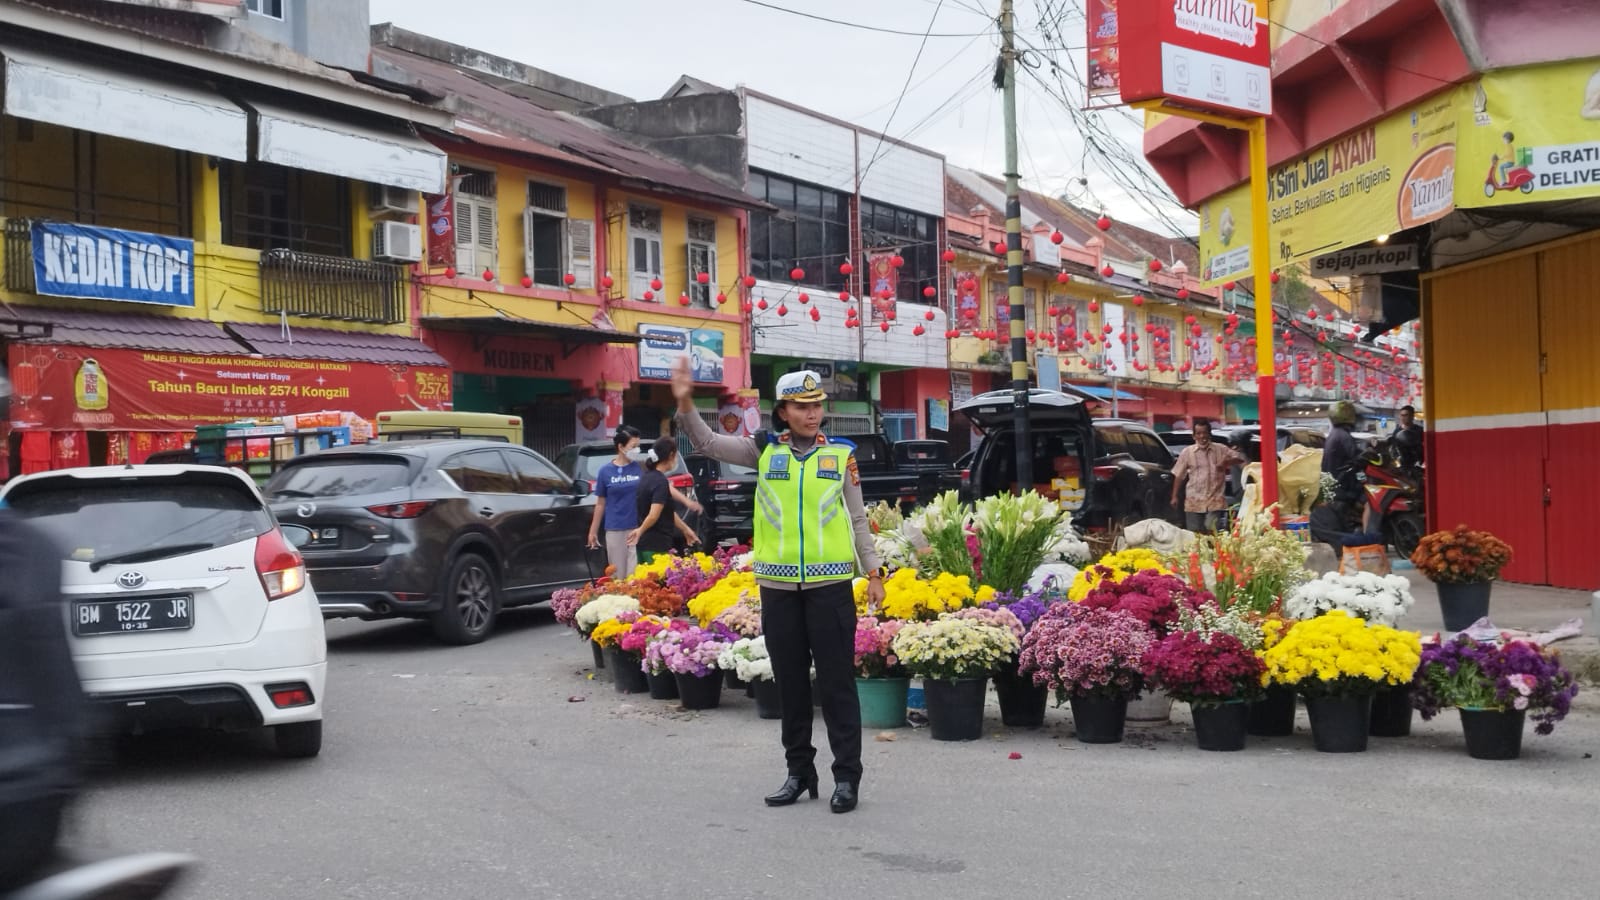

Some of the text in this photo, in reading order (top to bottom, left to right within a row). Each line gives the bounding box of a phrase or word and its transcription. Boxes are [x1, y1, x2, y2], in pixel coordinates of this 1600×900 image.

[1276, 164, 1299, 199] Sini
[1301, 147, 1329, 189] Jual
[1331, 126, 1377, 177] AYAM
[1339, 181, 1354, 199] dan
[1356, 165, 1391, 194] Higienis
[43, 232, 189, 295] KEDAI KOPI
[1315, 246, 1413, 272] sejajarkopi
[143, 354, 177, 363] MAJELIS
[178, 356, 204, 364] TINGGI
[205, 357, 233, 366] AGAMA
[279, 360, 315, 369] INDONESIA
[483, 350, 555, 372] MODREN
[217, 370, 291, 382] Selamat Hari Raya
[148, 380, 350, 399] Tahun Baru Imlek 2574 Kongzili
[419, 382, 449, 396] 2574
[79, 600, 187, 624] BM 1522 JR
